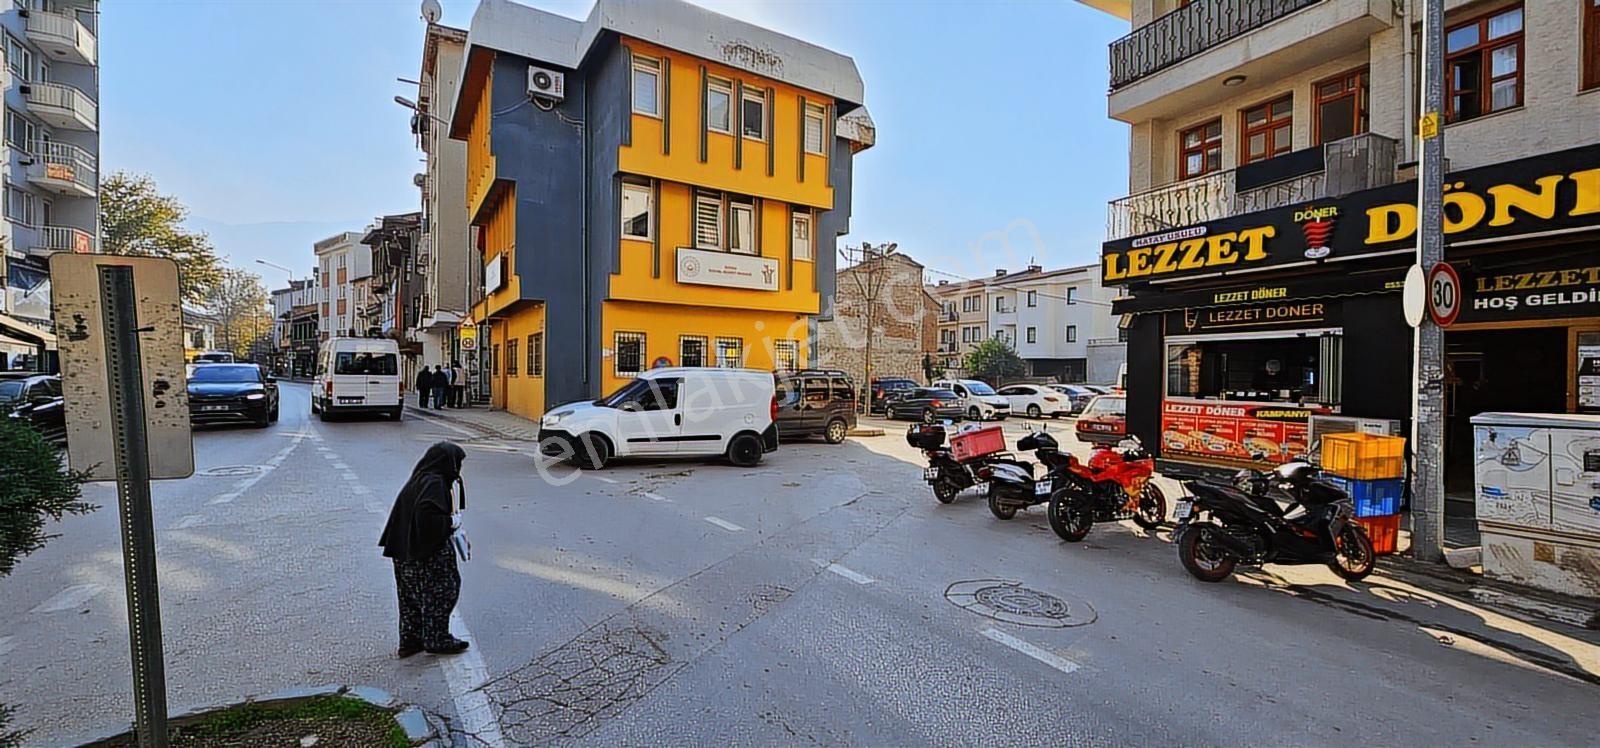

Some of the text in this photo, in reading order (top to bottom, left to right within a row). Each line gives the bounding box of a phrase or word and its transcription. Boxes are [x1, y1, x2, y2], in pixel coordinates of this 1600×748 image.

[1294, 205, 1338, 222] DÖNER
[1104, 225, 1275, 281] LEZZET
[1475, 267, 1600, 292] LEZZET
[1214, 286, 1287, 304] LEZZET DÖNER
[1433, 280, 1451, 308] 30
[1474, 287, 1600, 311] HOŞ GELDİ
[1209, 308, 1262, 323] LEZZET
[1165, 403, 1205, 414] LEZZET
